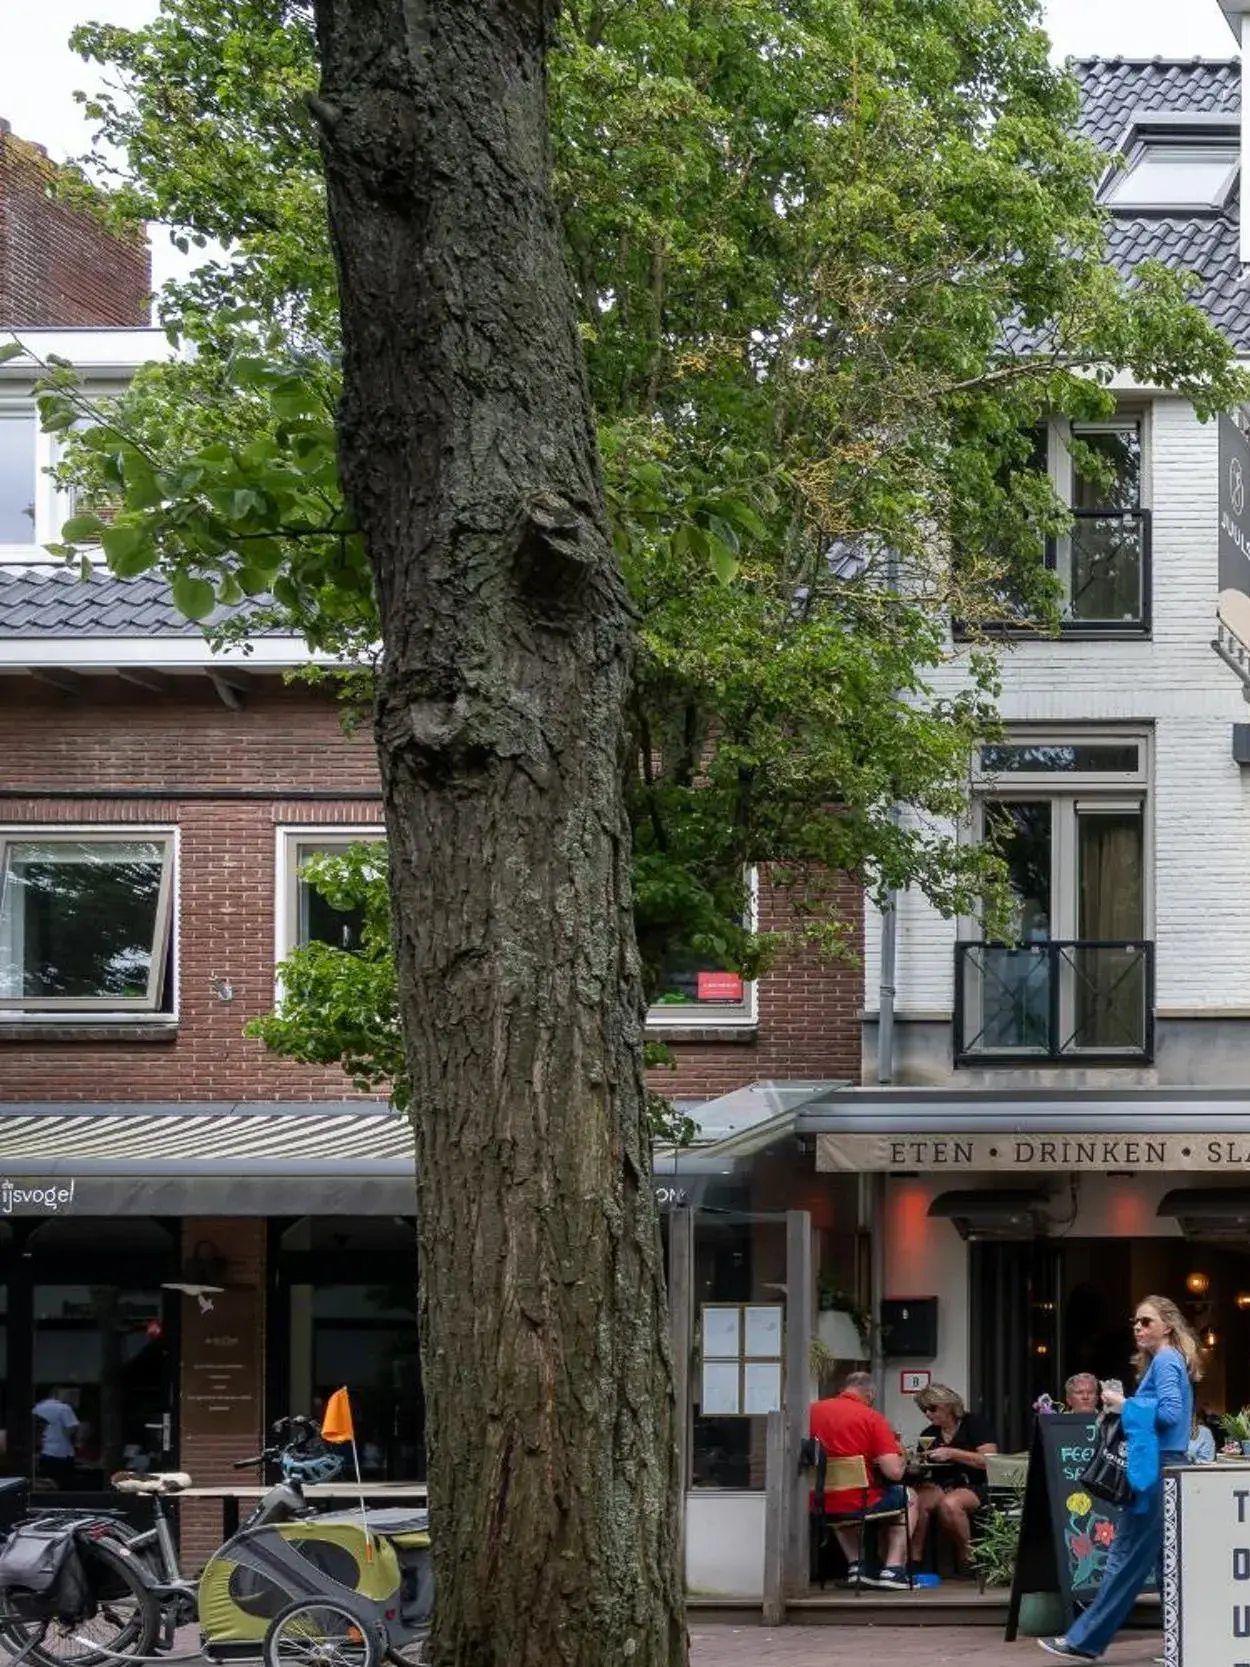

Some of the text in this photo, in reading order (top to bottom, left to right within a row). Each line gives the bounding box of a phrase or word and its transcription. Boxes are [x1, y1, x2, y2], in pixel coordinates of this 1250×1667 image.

[890, 1143, 973, 1163] ETEN
[1015, 1143, 1167, 1163] DRINKEN
[1233, 1490, 1250, 1667] TOU
